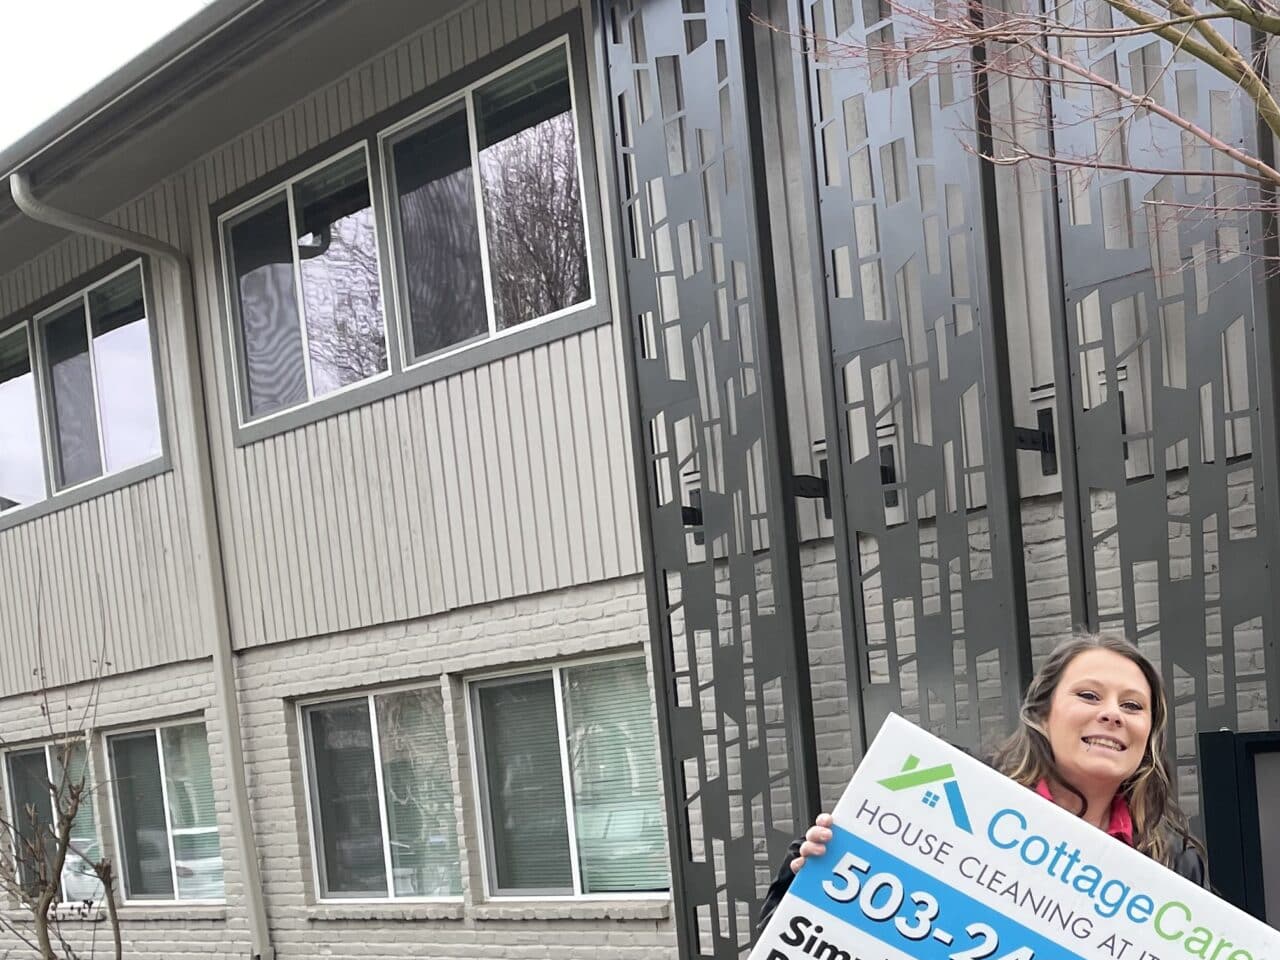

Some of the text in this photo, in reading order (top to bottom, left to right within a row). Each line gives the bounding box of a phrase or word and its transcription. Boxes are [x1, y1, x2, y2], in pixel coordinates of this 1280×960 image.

[855, 799, 954, 865] HOUSE
[958, 856, 1095, 939] CLEANING
[1097, 933, 1133, 960] AT
